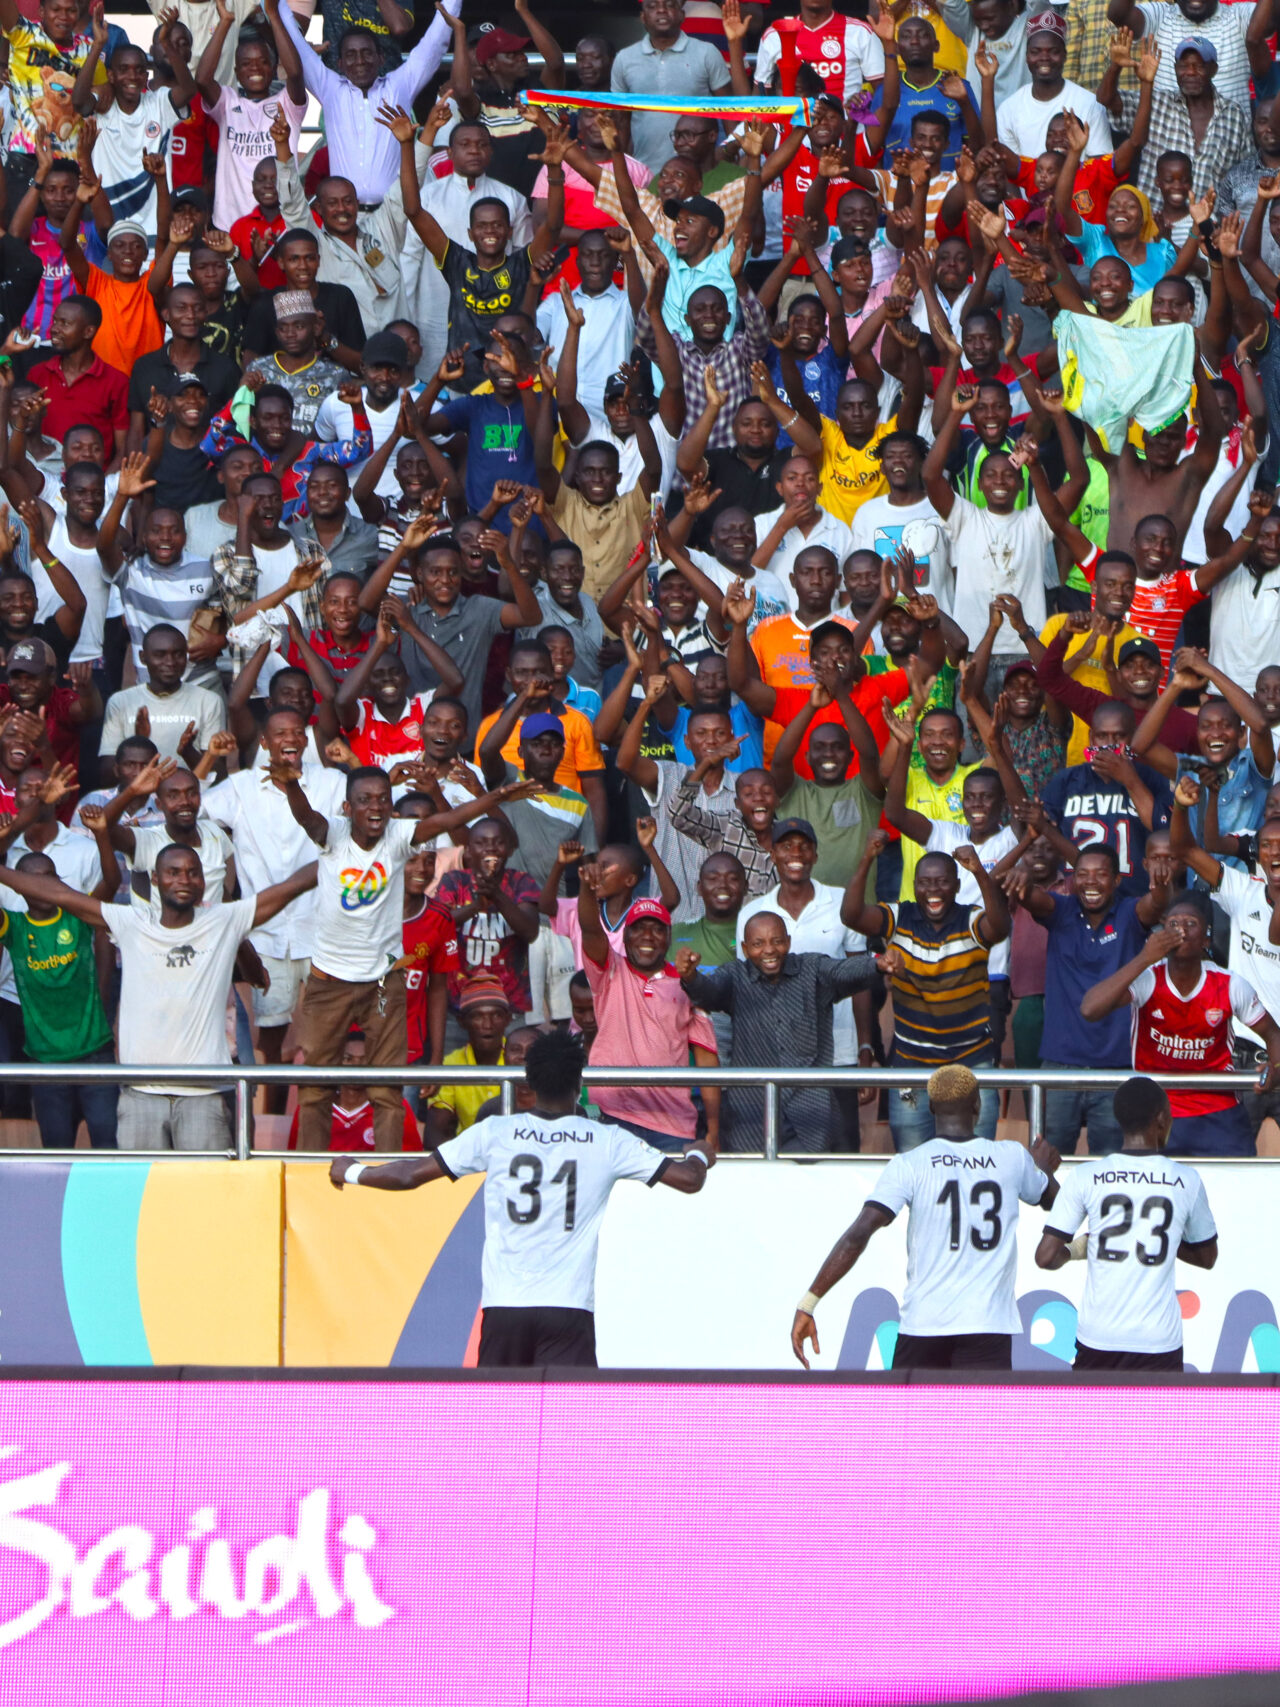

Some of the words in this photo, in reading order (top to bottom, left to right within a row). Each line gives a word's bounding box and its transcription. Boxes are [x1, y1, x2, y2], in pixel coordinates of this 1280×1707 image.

[227, 126, 272, 144] Emirate
[190, 584, 204, 594] FG
[466, 938, 505, 966] UP.
[1150, 1027, 1215, 1050] Emirates
[1157, 1044, 1170, 1056] FLY
[1172, 1048, 1206, 1061] BETTER
[513, 1127, 594, 1144] KALONJI
[931, 1154, 996, 1169] FOFANA
[1094, 1170, 1185, 1188] MORTALLA
[506, 1153, 578, 1232] 31
[935, 1178, 1003, 1252] 13
[1096, 1192, 1174, 1266] 23
